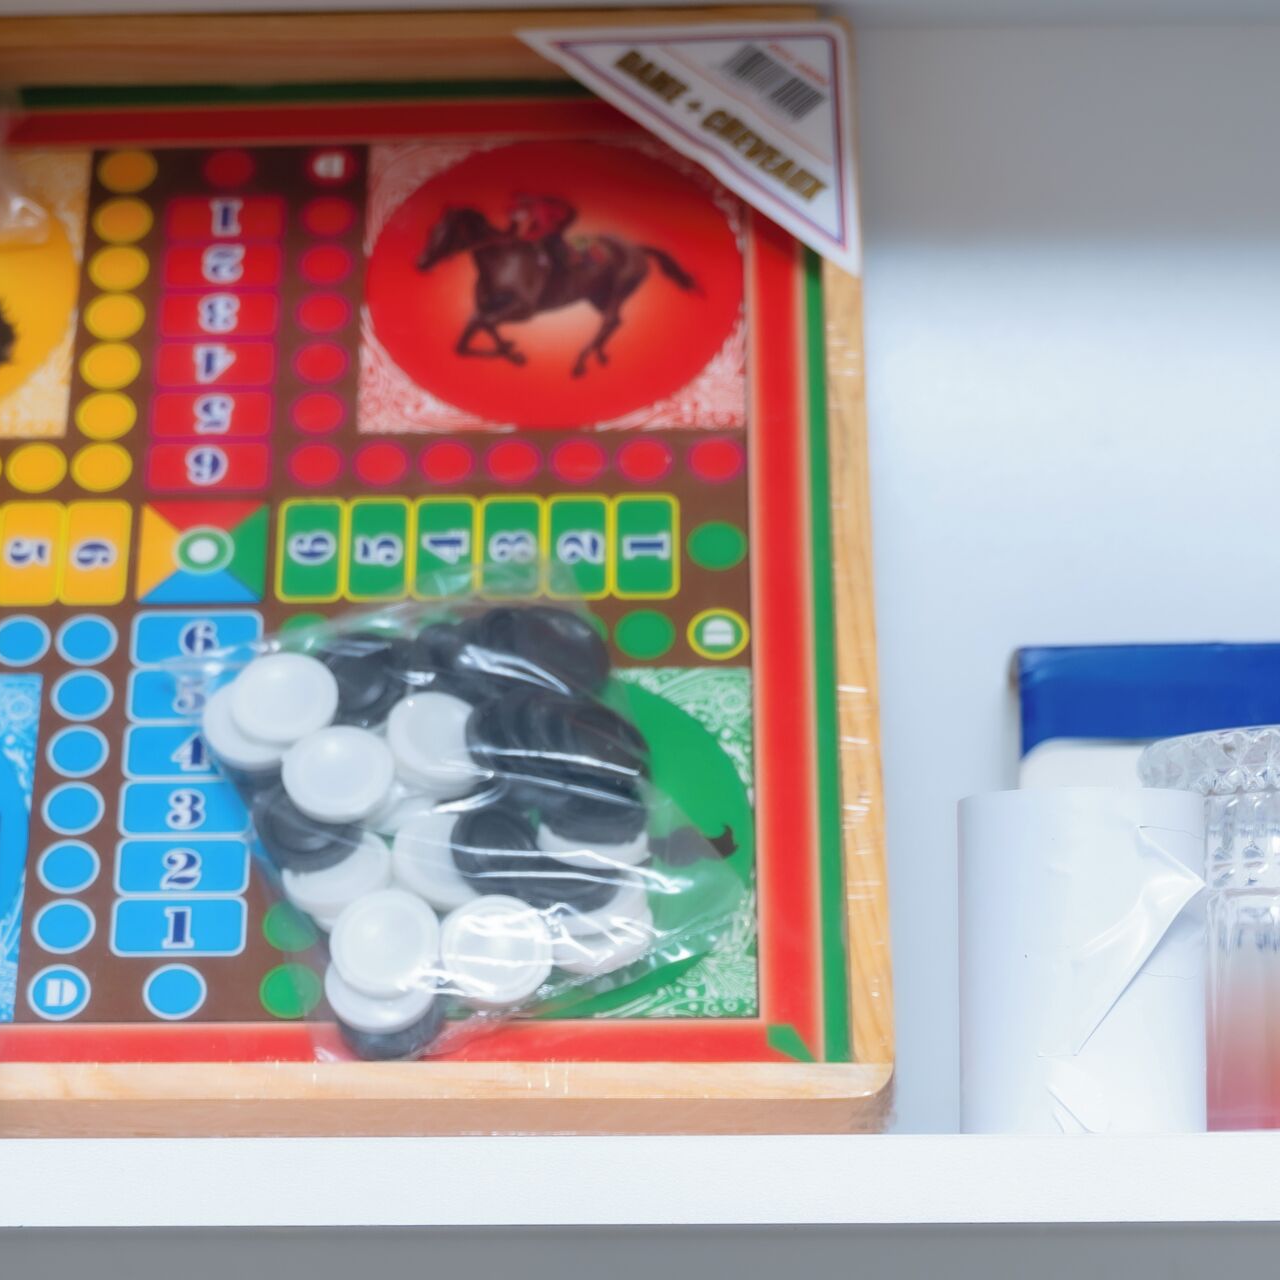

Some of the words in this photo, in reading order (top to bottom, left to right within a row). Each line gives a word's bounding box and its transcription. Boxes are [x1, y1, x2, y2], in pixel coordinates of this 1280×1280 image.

[179, 619, 219, 657] 6
[171, 726, 211, 771] 4
[166, 788, 206, 830] 3
[160, 847, 202, 890] 2
[162, 906, 194, 949] 1
